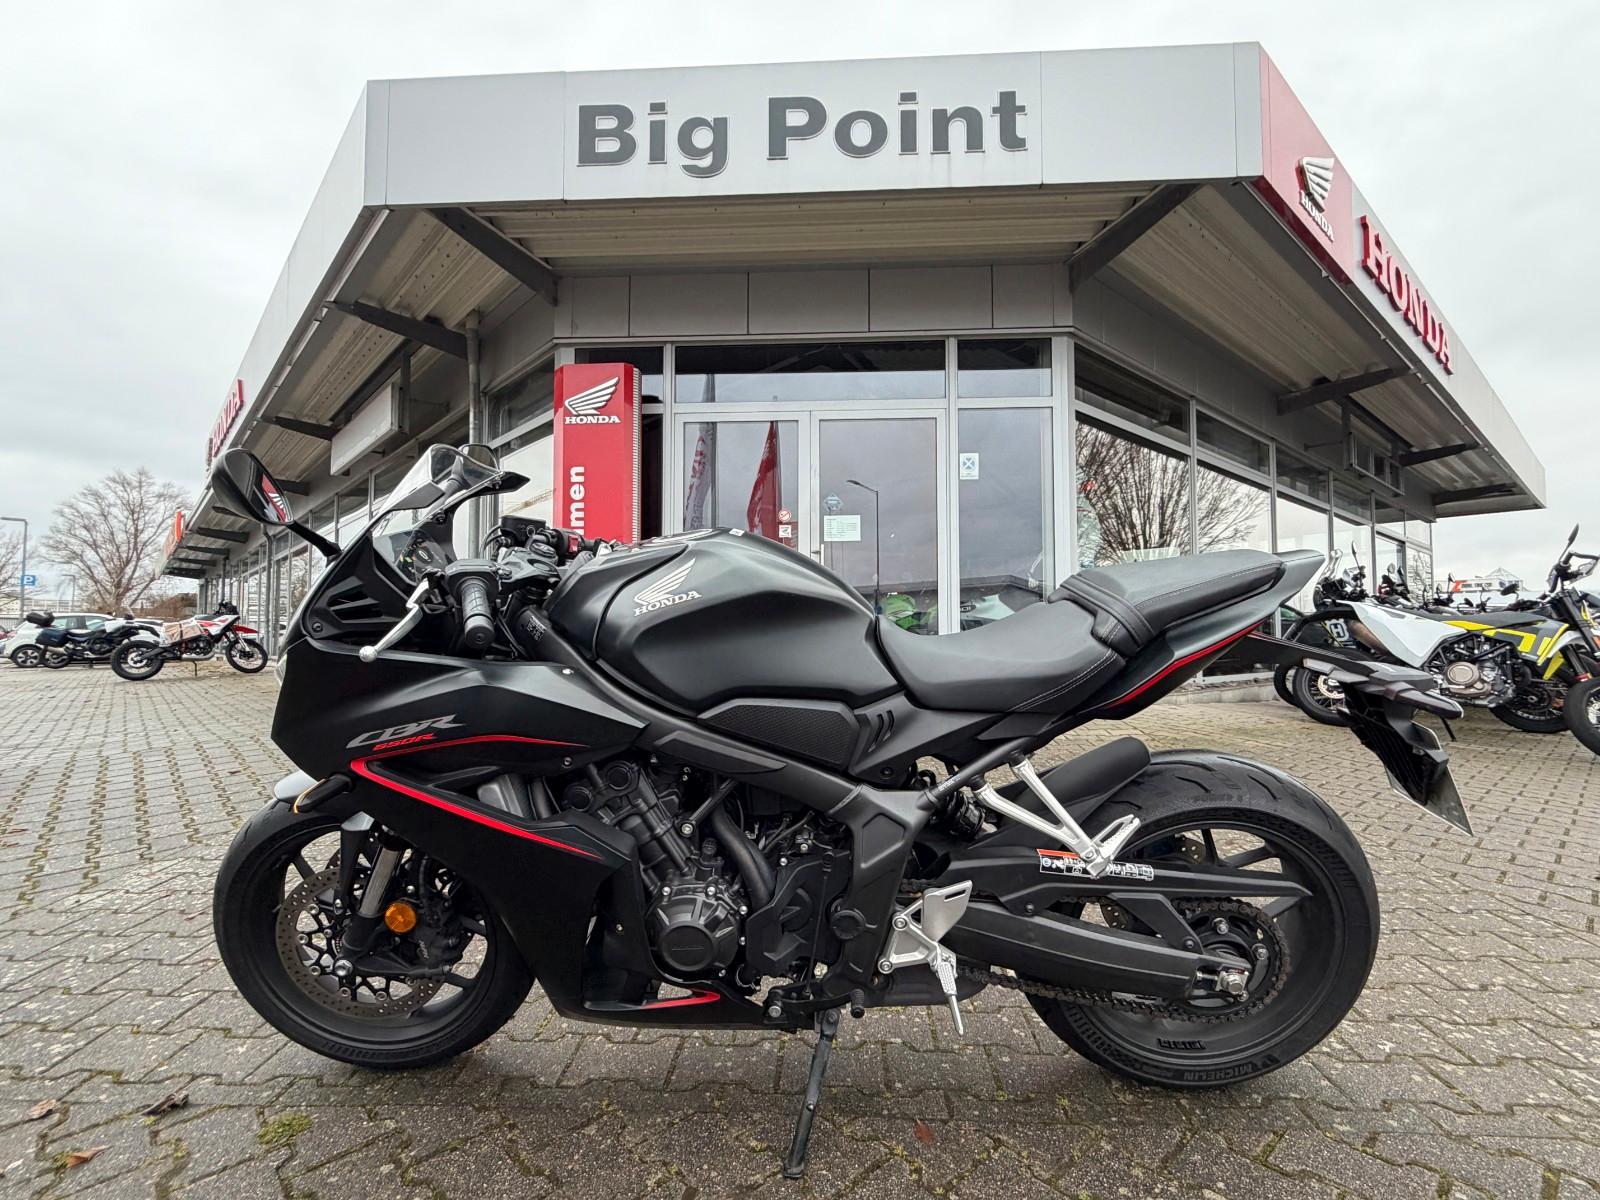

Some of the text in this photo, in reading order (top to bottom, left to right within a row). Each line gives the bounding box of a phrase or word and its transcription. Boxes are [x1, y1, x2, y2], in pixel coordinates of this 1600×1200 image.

[577, 90, 1028, 178] Big Point
[1299, 189, 1335, 243] HONDA
[1359, 214, 1453, 376] HONDA
[564, 414, 622, 425] HONDA
[569, 466, 586, 536] men
[23, 575, 34, 585] P
[633, 590, 703, 617] HONDA
[345, 713, 466, 749] CBR
